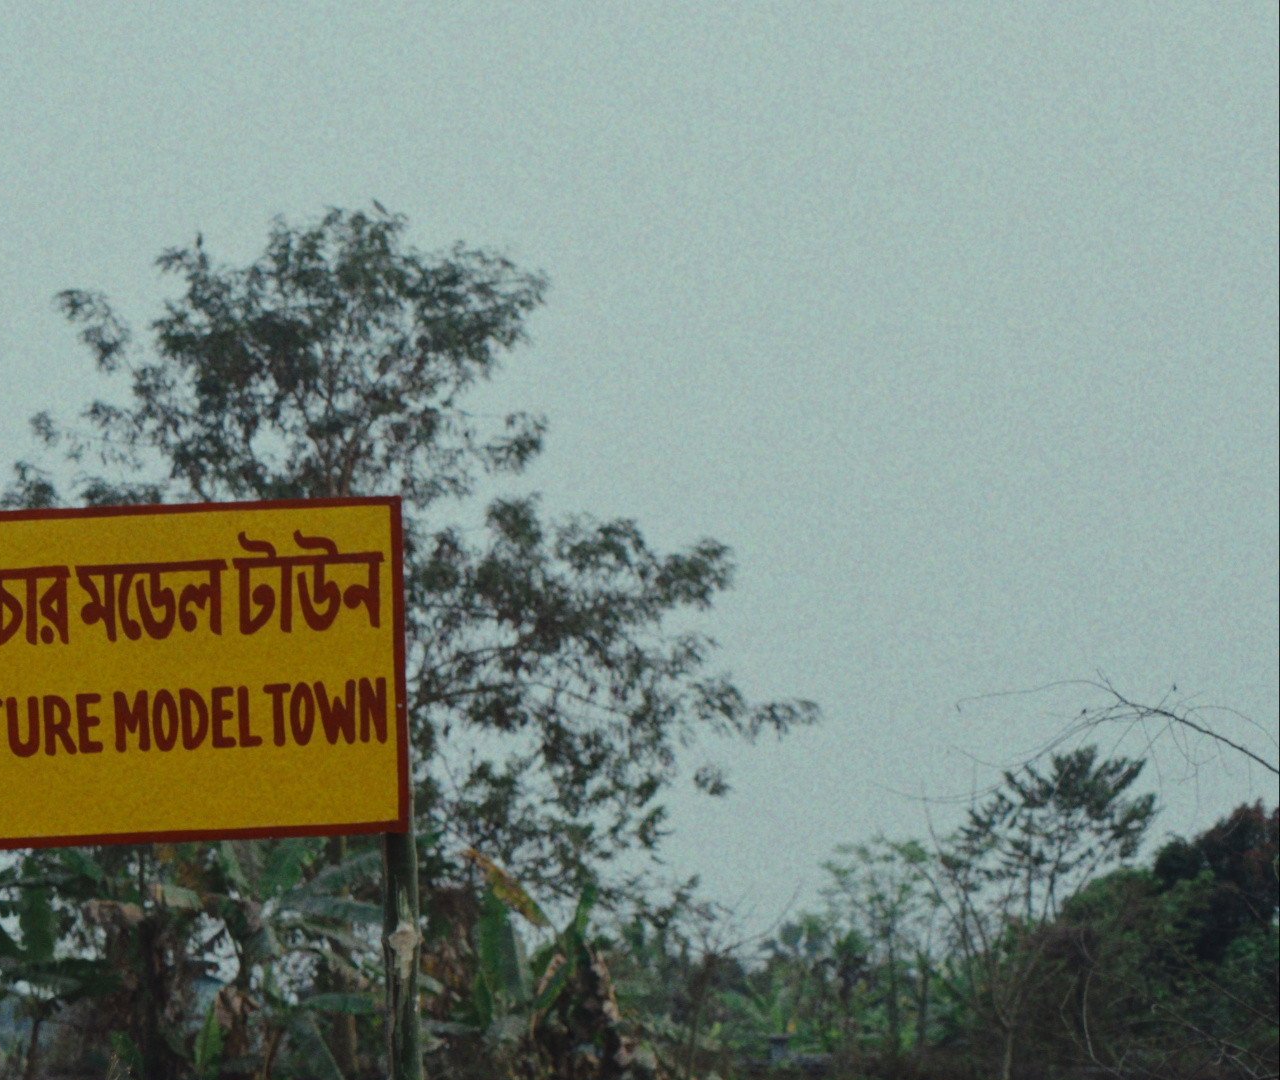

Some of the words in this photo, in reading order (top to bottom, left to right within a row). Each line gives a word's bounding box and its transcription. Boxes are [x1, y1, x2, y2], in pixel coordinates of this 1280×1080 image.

[74, 557, 229, 643] মডেল
[231, 529, 386, 636] টাউন
[112, 685, 264, 754] MODEL
[263, 676, 389, 748] TOWN
